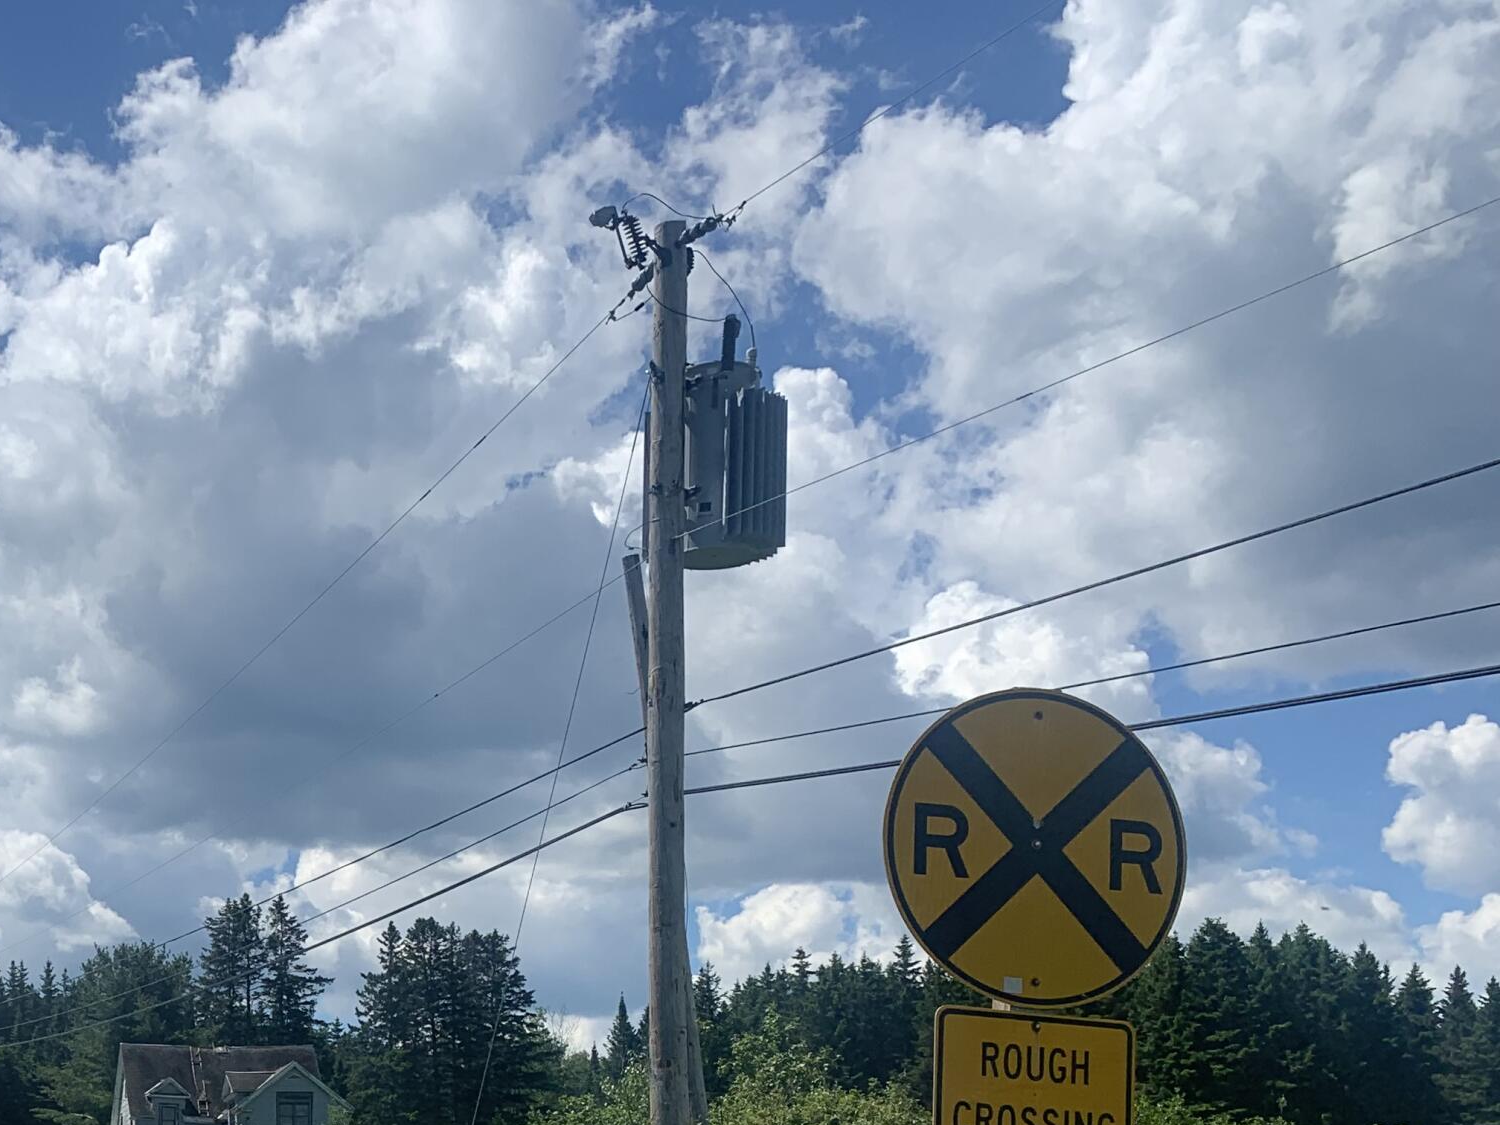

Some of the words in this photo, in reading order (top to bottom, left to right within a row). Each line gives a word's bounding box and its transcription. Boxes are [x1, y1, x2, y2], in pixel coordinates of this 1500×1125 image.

[913, 801, 970, 879] R
[1108, 818, 1163, 895] R
[981, 1041, 1090, 1086] ROUGH
